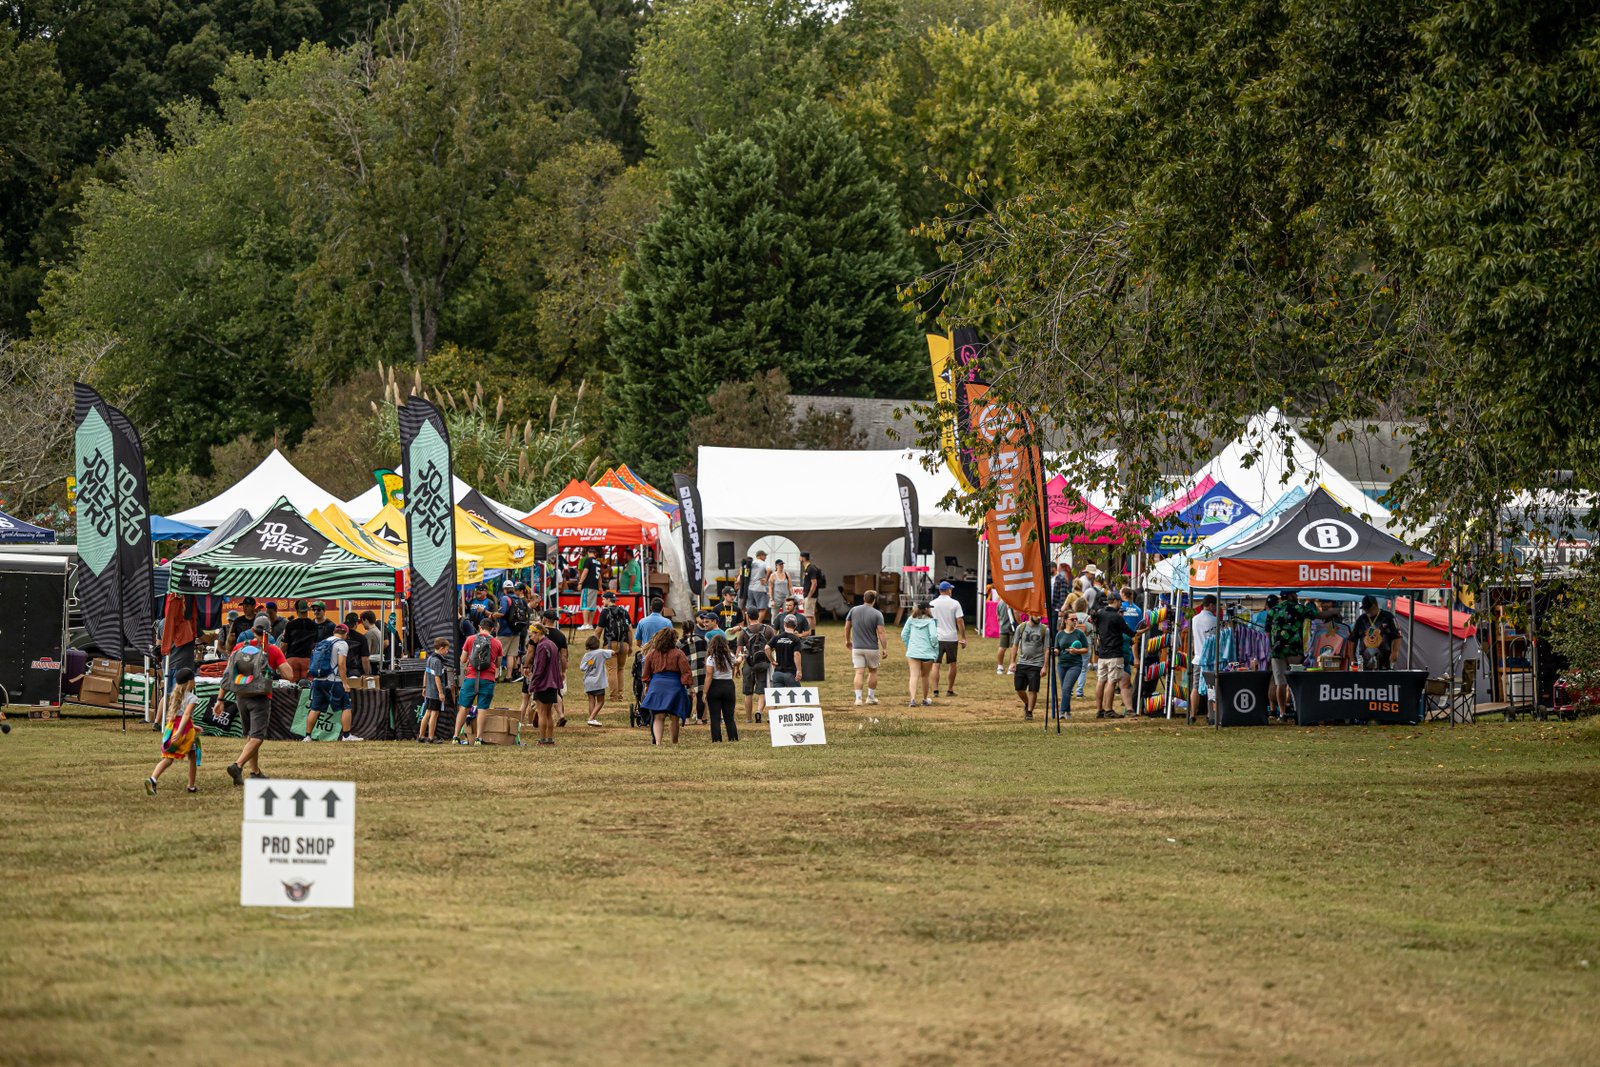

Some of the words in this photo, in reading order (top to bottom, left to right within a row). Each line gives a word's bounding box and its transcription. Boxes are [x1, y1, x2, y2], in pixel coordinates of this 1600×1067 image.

[256, 522, 288, 536] JO
[1316, 525, 1340, 548] B
[260, 532, 309, 549] MEZ
[1298, 564, 1372, 582] Bushnell
[1319, 684, 1399, 702] Bushnell
[1369, 701, 1399, 713] DISC
[778, 713, 793, 724] PRO
[795, 712, 815, 722] SHOP
[261, 836, 290, 854] PRO
[296, 837, 335, 855] SHOP
